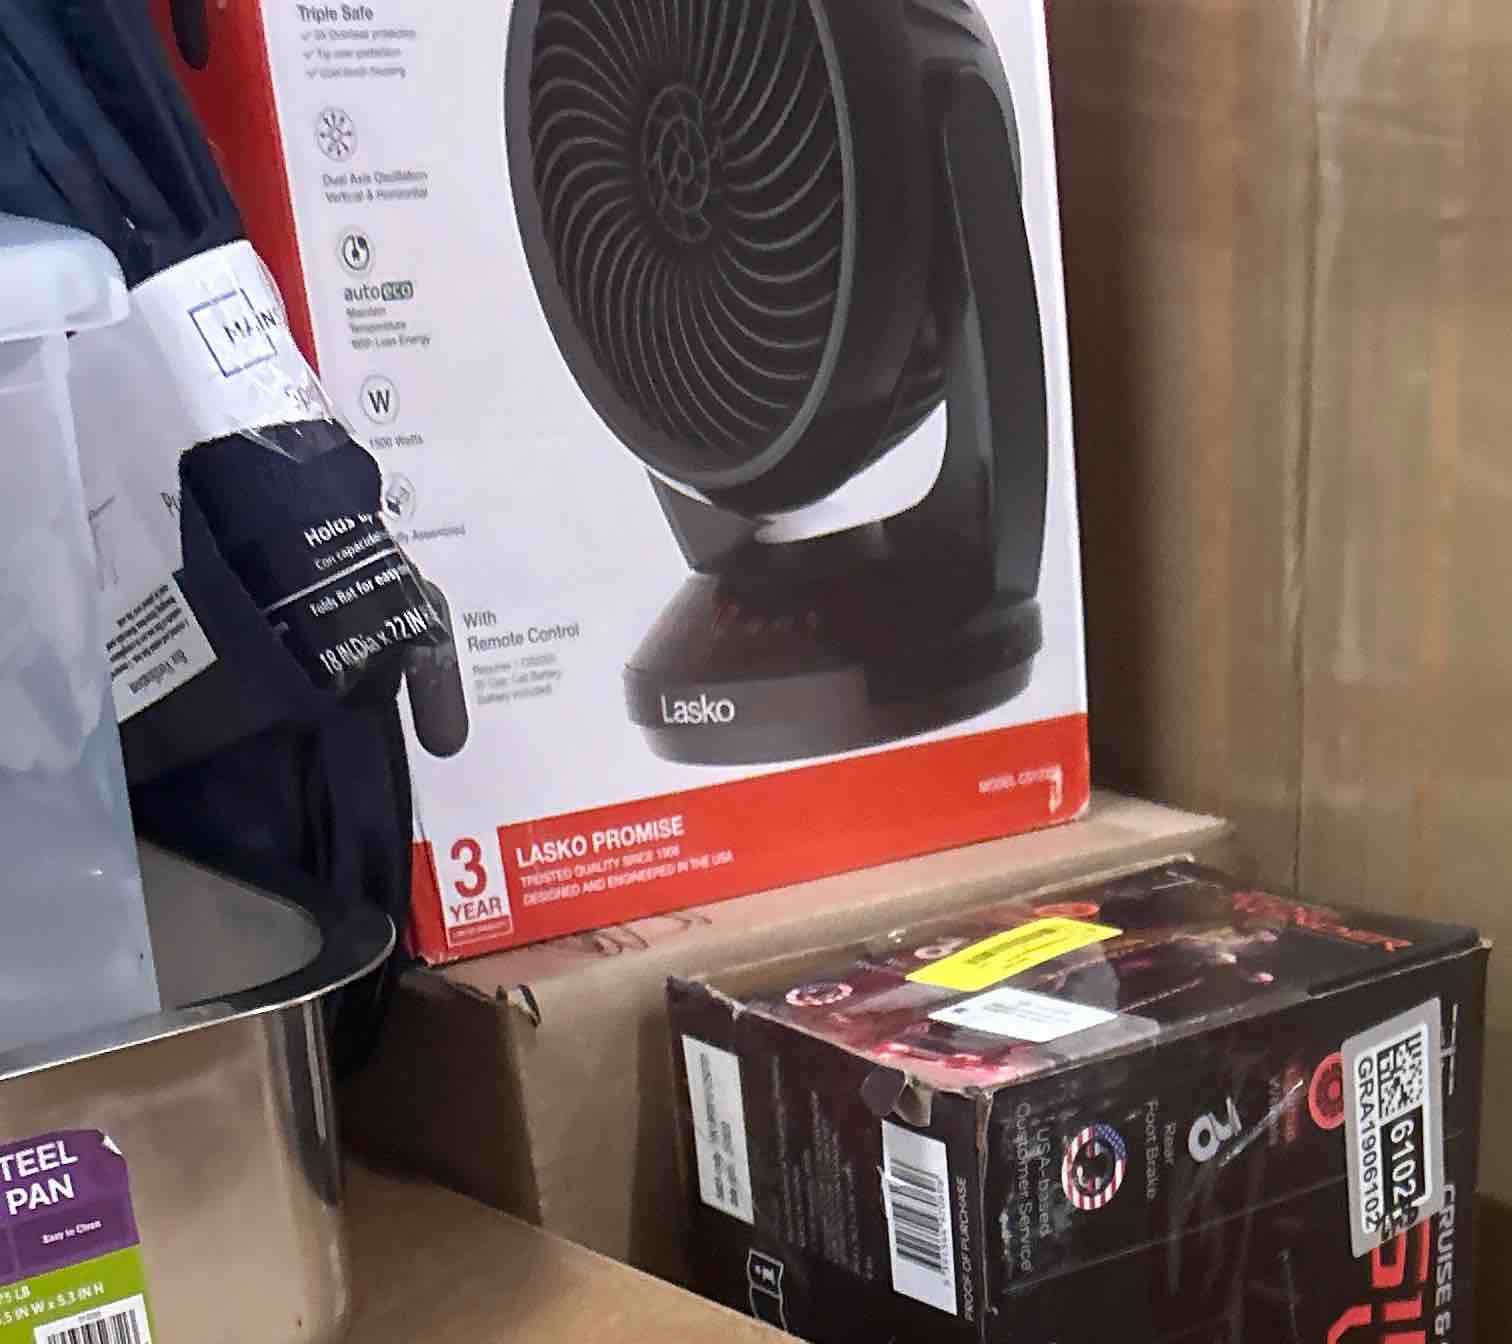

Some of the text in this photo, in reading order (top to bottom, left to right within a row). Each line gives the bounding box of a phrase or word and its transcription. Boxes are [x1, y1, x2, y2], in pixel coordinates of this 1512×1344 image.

[296, 3, 374, 24] Triple Safe
[322, 173, 347, 186] Dual
[354, 577, 375, 596] for
[462, 610, 497, 629] With
[467, 623, 580, 653] Remote Control
[661, 694, 735, 725] Lasko
[515, 815, 685, 868] LASKO PROMISE
[450, 837, 487, 898] 3
[574, 857, 620, 878] QUALITY
[711, 849, 735, 867] USA
[450, 896, 502, 922] YEAR
[0, 1140, 78, 1182] TEEL
[5, 1173, 75, 1216] PAN
[1018, 1202, 1034, 1274] Service
[1433, 1184, 1457, 1308] CRUISE
[1434, 1310, 1450, 1334] &
